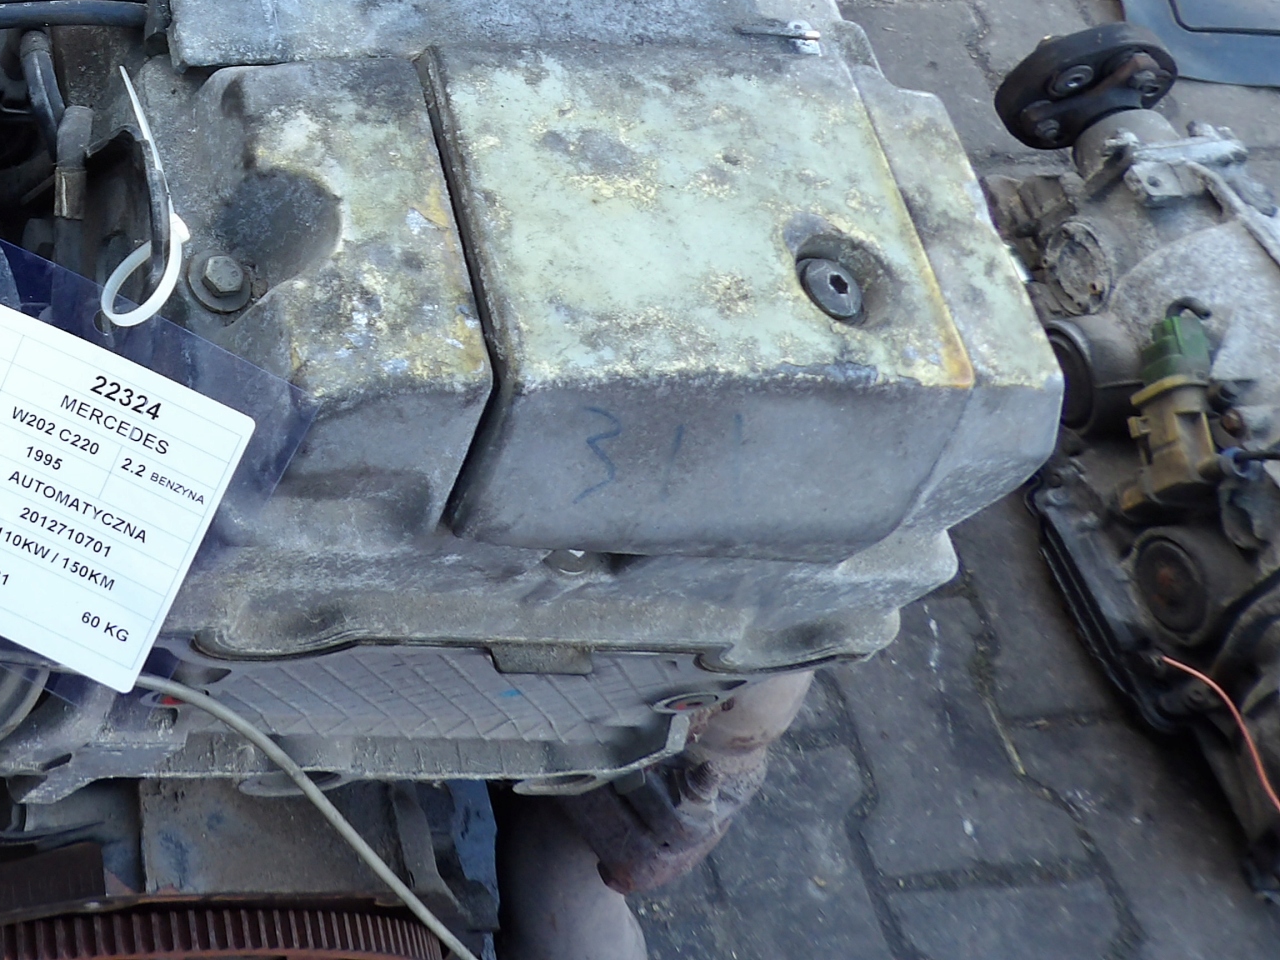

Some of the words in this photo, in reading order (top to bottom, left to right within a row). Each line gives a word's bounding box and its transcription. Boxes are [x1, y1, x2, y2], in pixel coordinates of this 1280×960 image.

[89, 375, 162, 421] 22324
[12, 406, 56, 436] W202
[59, 428, 100, 455] C220
[60, 394, 170, 455] MERCEDES
[26, 446, 63, 471] 1995
[120, 457, 146, 478] 2.2
[150, 471, 204, 505] BENZYNA
[7, 470, 146, 544] AUTOMATYCZNA
[19, 507, 112, 558] 2012710701
[81, 611, 101, 629] 60
[103, 621, 129, 642] KG
